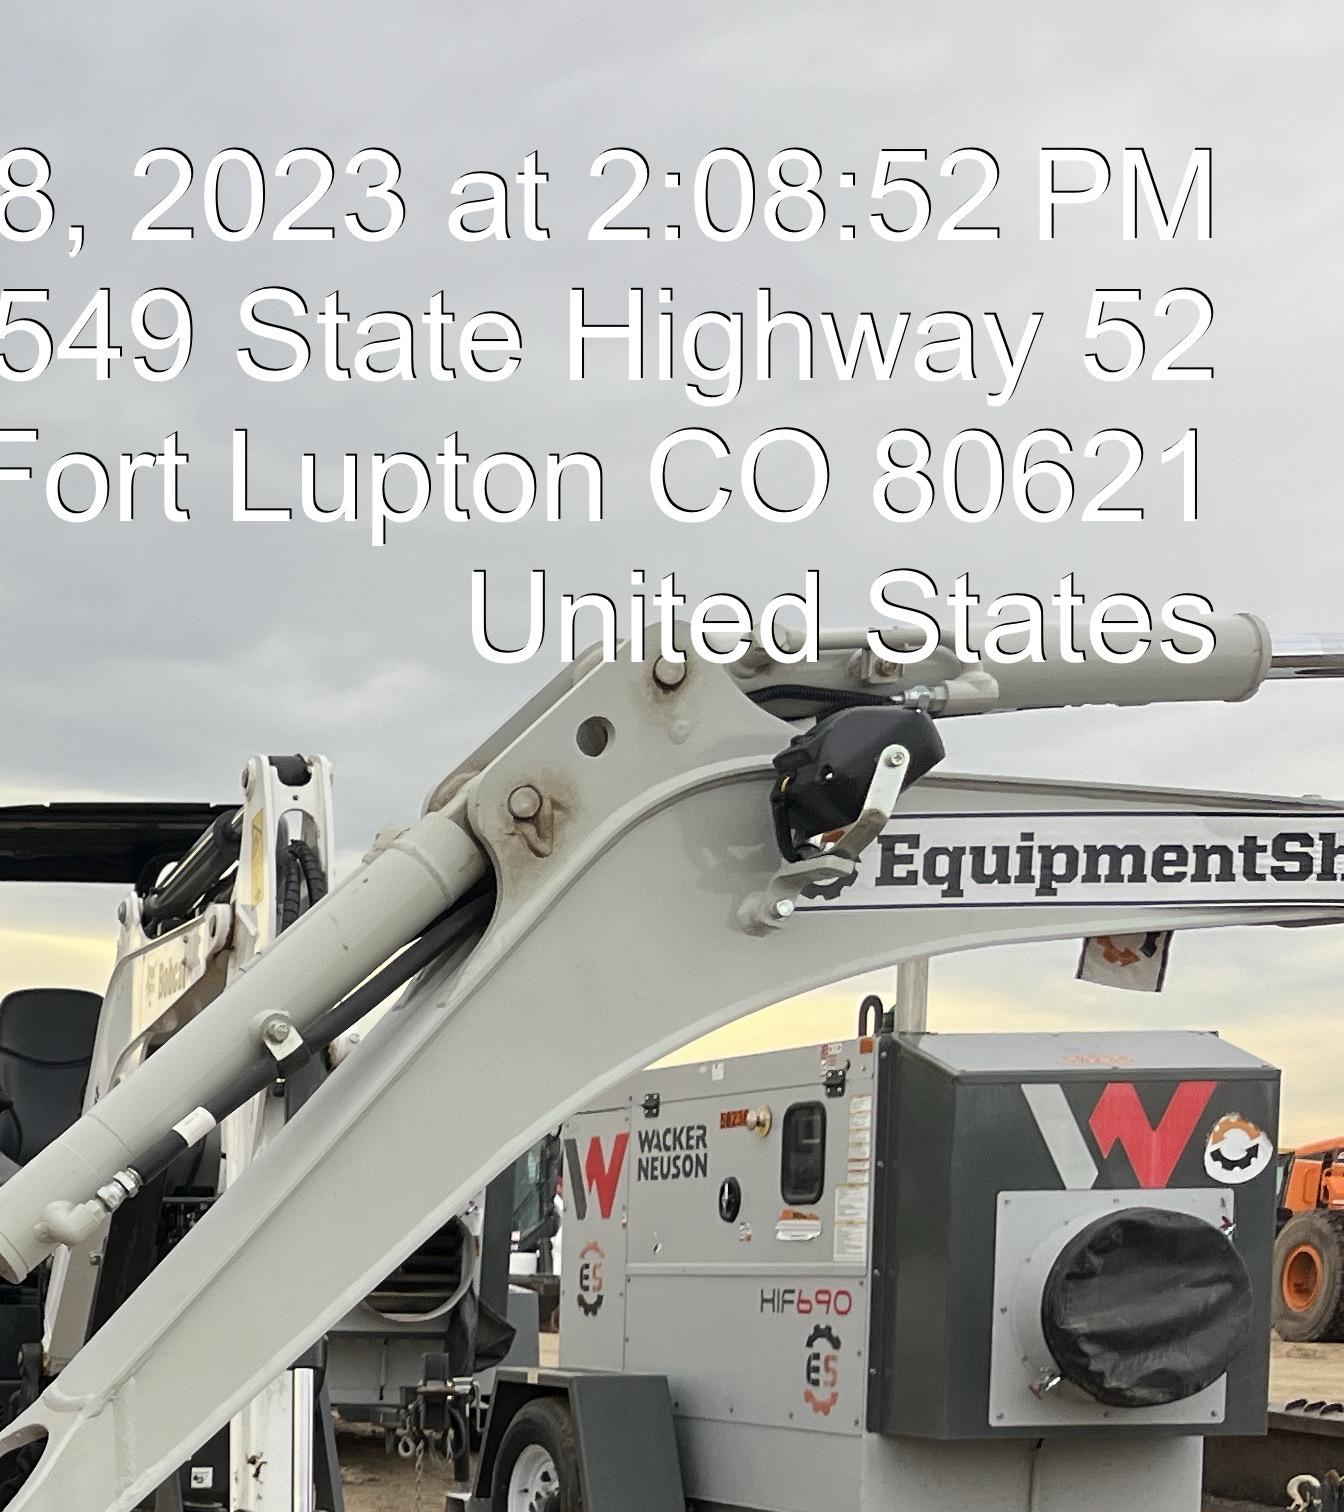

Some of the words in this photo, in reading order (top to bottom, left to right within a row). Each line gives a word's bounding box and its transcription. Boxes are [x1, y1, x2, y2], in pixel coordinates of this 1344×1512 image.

[637, 1124, 708, 1153] WACKER
[637, 1153, 708, 1182] NEUSON
[760, 1288, 853, 1315] HIF690
